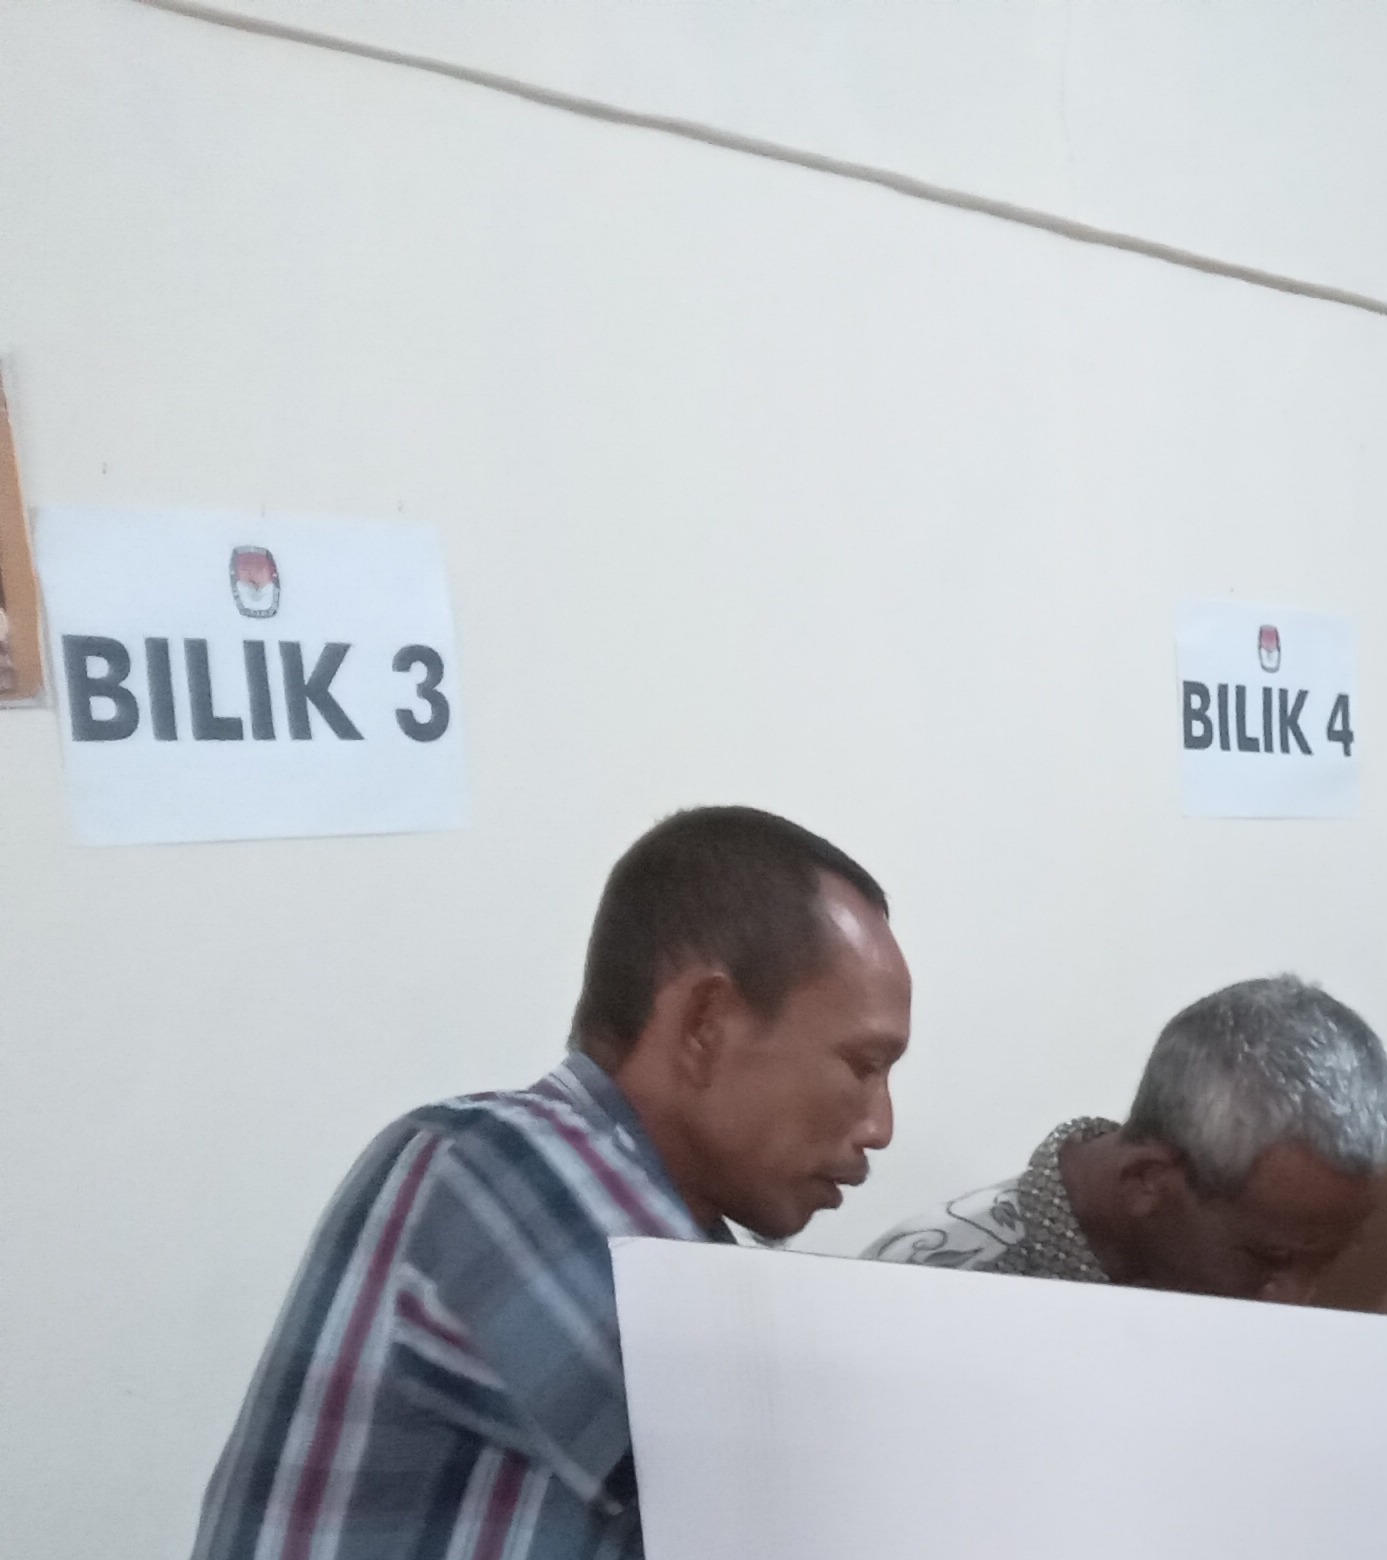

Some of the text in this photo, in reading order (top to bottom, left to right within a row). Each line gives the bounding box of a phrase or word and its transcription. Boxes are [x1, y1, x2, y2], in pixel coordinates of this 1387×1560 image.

[62, 634, 450, 743] BILIK 3
[1182, 680, 1354, 757] BILIK 4
